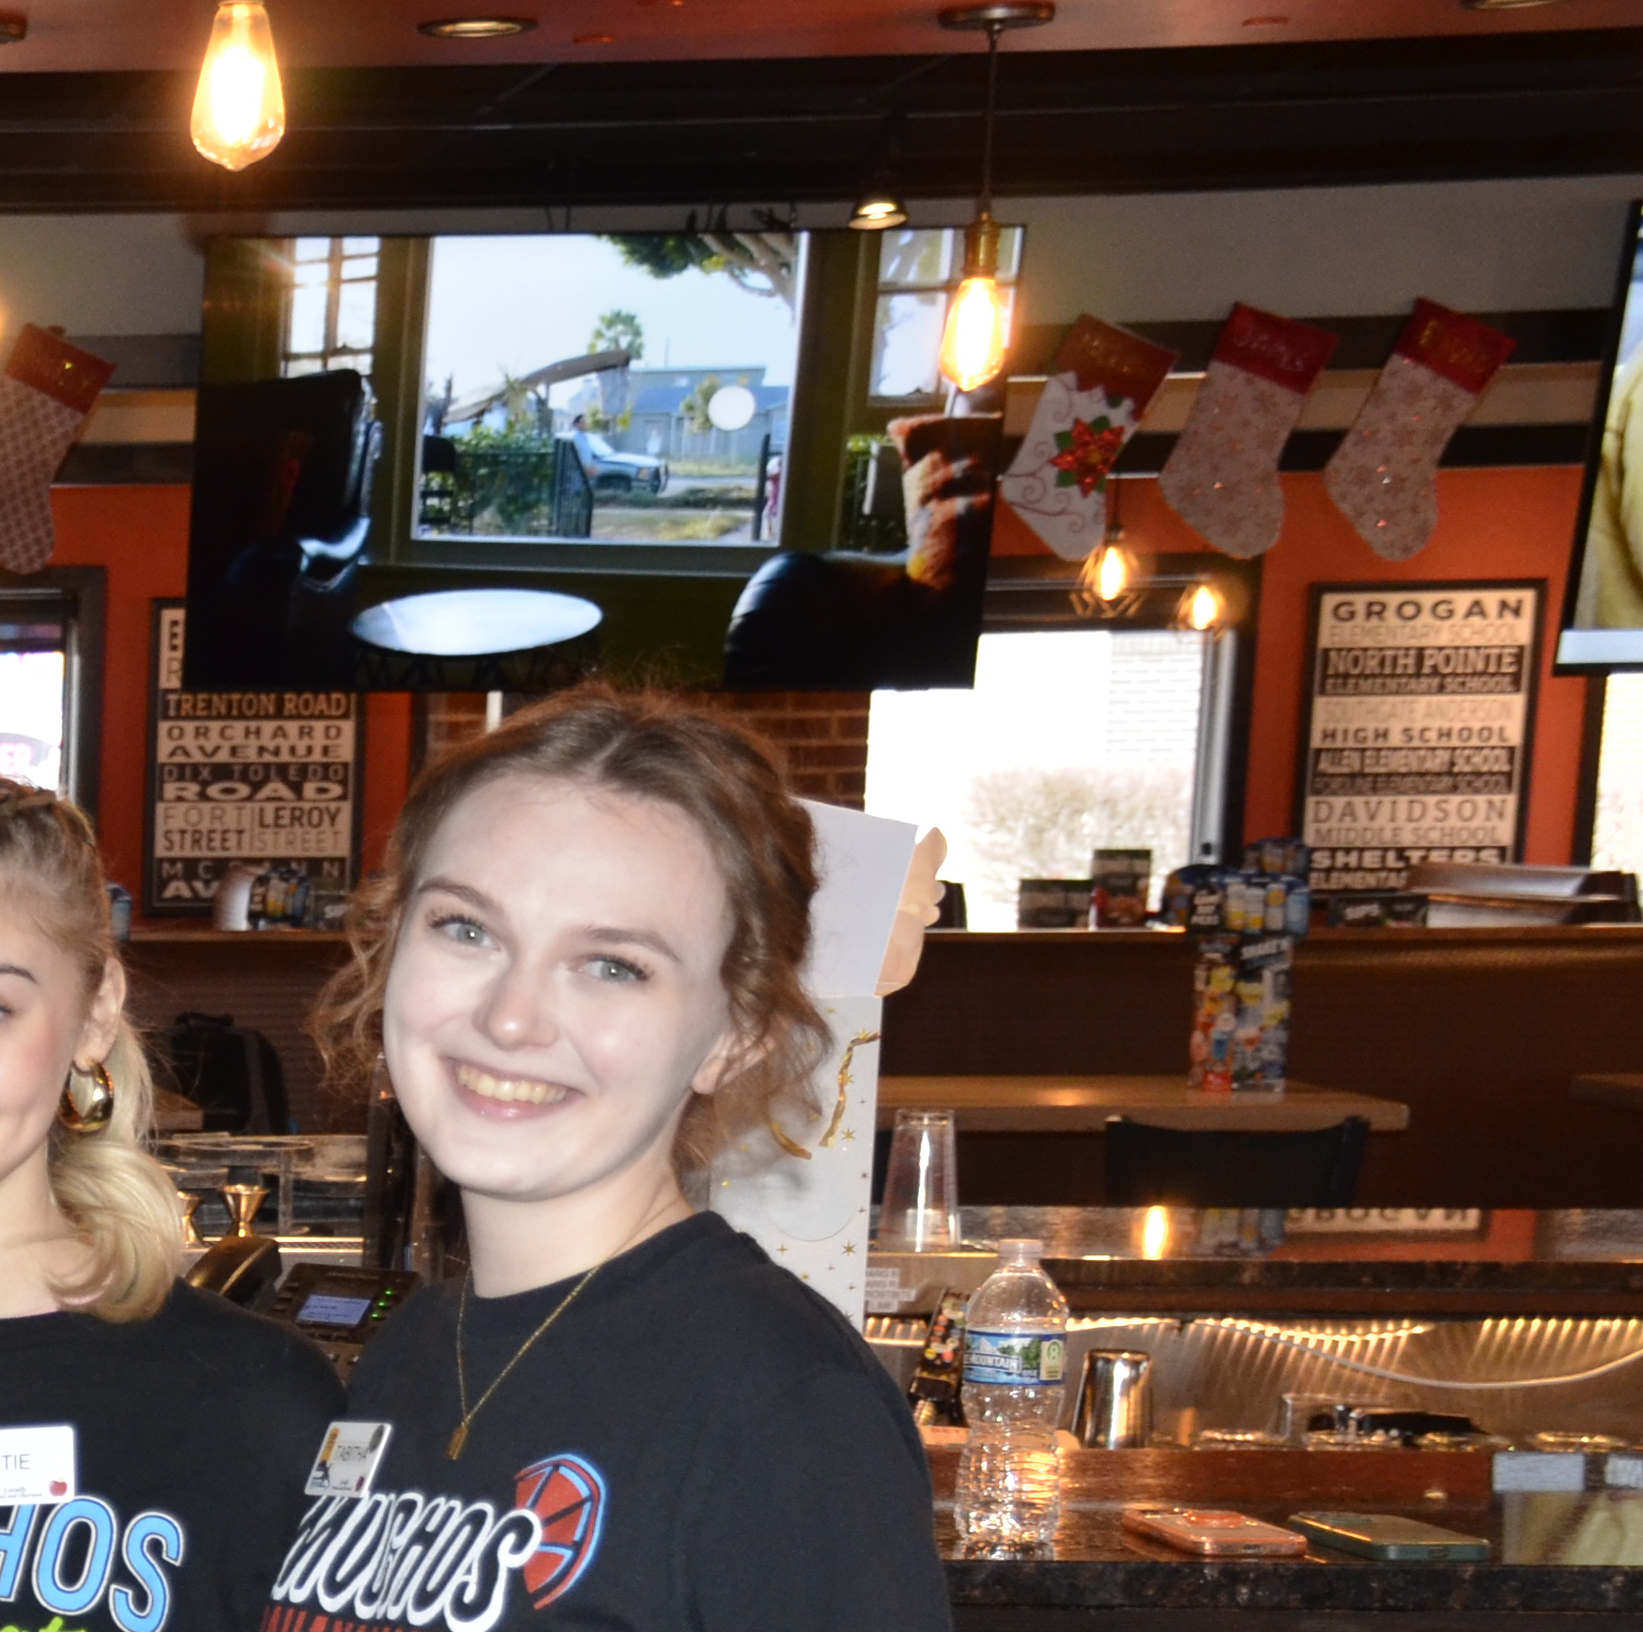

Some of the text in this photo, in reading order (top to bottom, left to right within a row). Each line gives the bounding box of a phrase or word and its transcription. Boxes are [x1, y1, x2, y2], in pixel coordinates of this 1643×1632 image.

[1332, 600, 1523, 622] GROGAN
[1448, 624, 1518, 643] SCHOOL
[1327, 647, 1519, 675] NORTH POINTE
[1325, 675, 1515, 694] ELEMENTARY SCHOOL
[166, 692, 348, 717] TRENTON ROAD
[166, 725, 343, 742] ORCHARD
[1321, 725, 1509, 744] HIGH SCHOOL
[166, 745, 341, 759] AVENUE
[1453, 748, 1512, 772] SCHOOL
[164, 765, 345, 781] DIX TOLEDO
[163, 781, 344, 801] ROAD
[164, 806, 249, 828] FORT
[258, 806, 342, 829] LEROY
[1312, 799, 1507, 823] DAVIDSON
[164, 829, 247, 851] STREET
[258, 831, 341, 851] STREET
[1315, 825, 1501, 845] MIDDLE SCHOOL
[1311, 848, 1501, 868] SHELTERS
